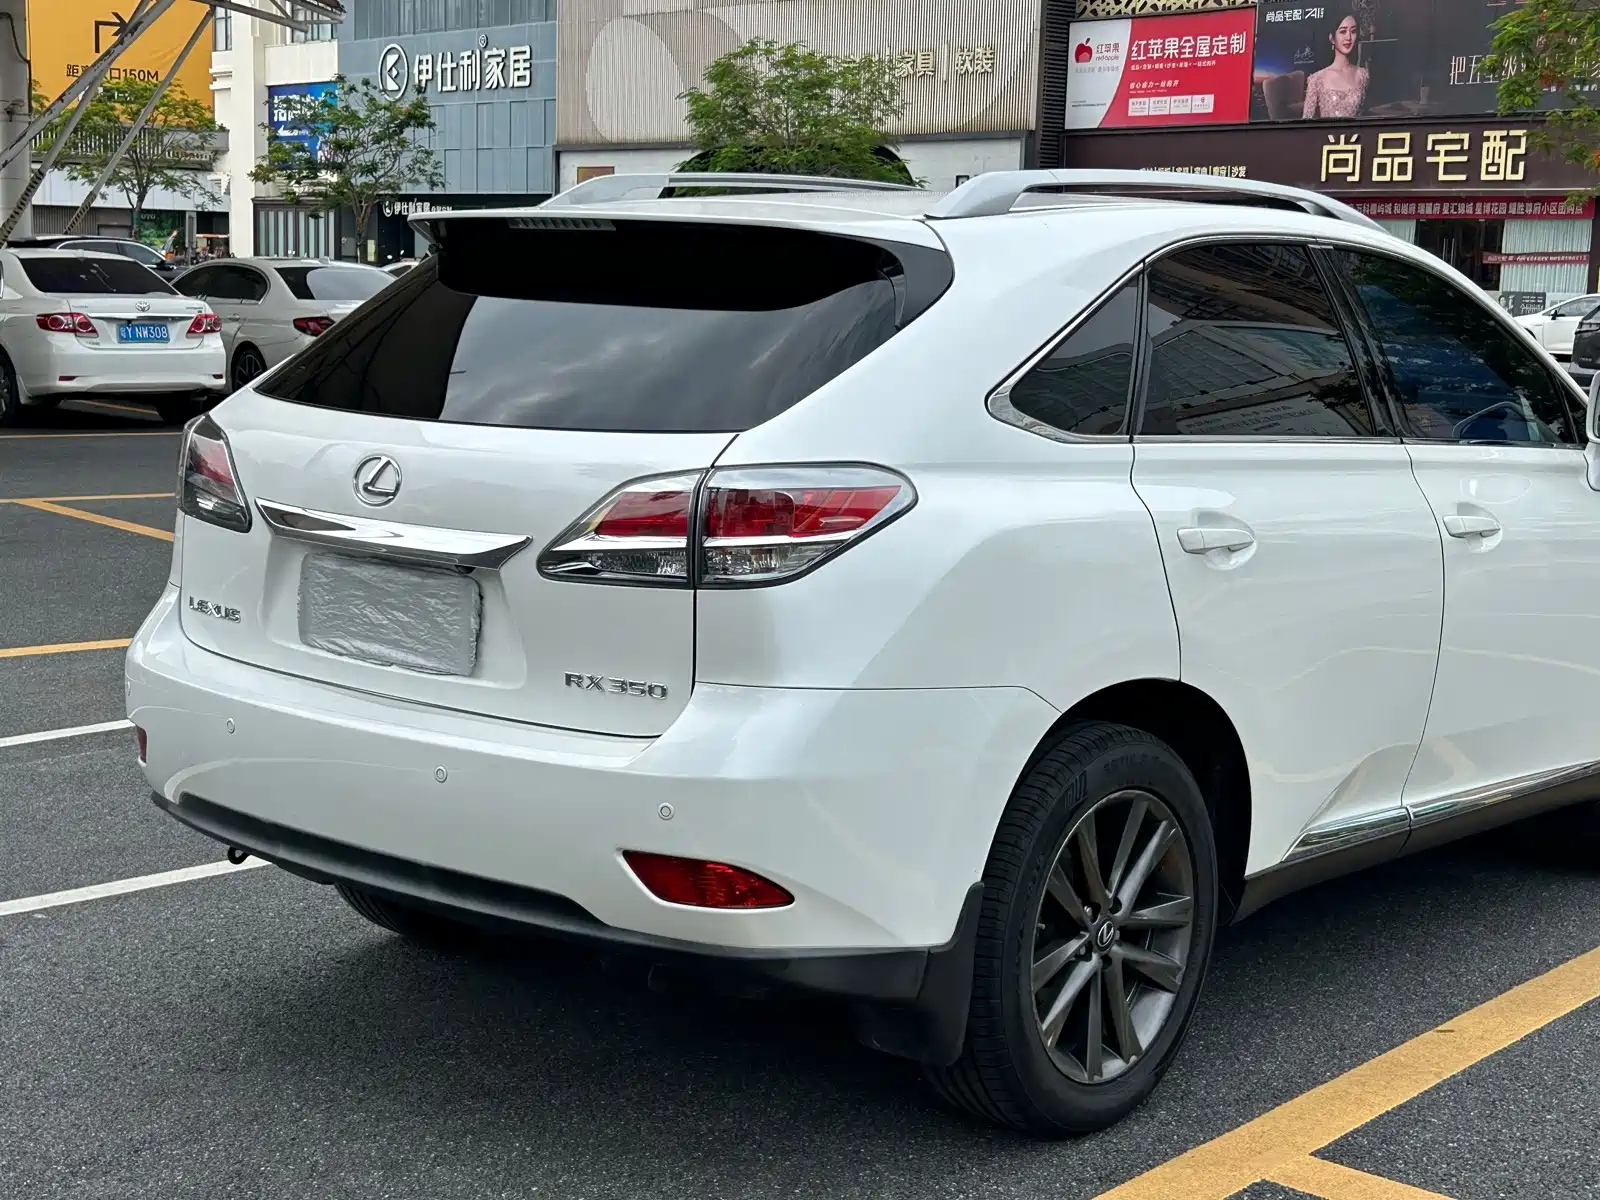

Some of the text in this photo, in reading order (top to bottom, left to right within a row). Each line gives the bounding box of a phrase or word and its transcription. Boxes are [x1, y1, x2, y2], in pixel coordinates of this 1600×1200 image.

[1266, 9, 1302, 22] 尚品宅配
[1096, 43, 1119, 54] 红苹果
[1131, 32, 1246, 61] 红苹果全屋定制
[414, 45, 531, 93] 伊仕利家居
[895, 51, 935, 77] 家具
[1321, 130, 1527, 182] 尚品宅配
[189, 596, 241, 623] LEXUS
[564, 671, 669, 700] RX 350
